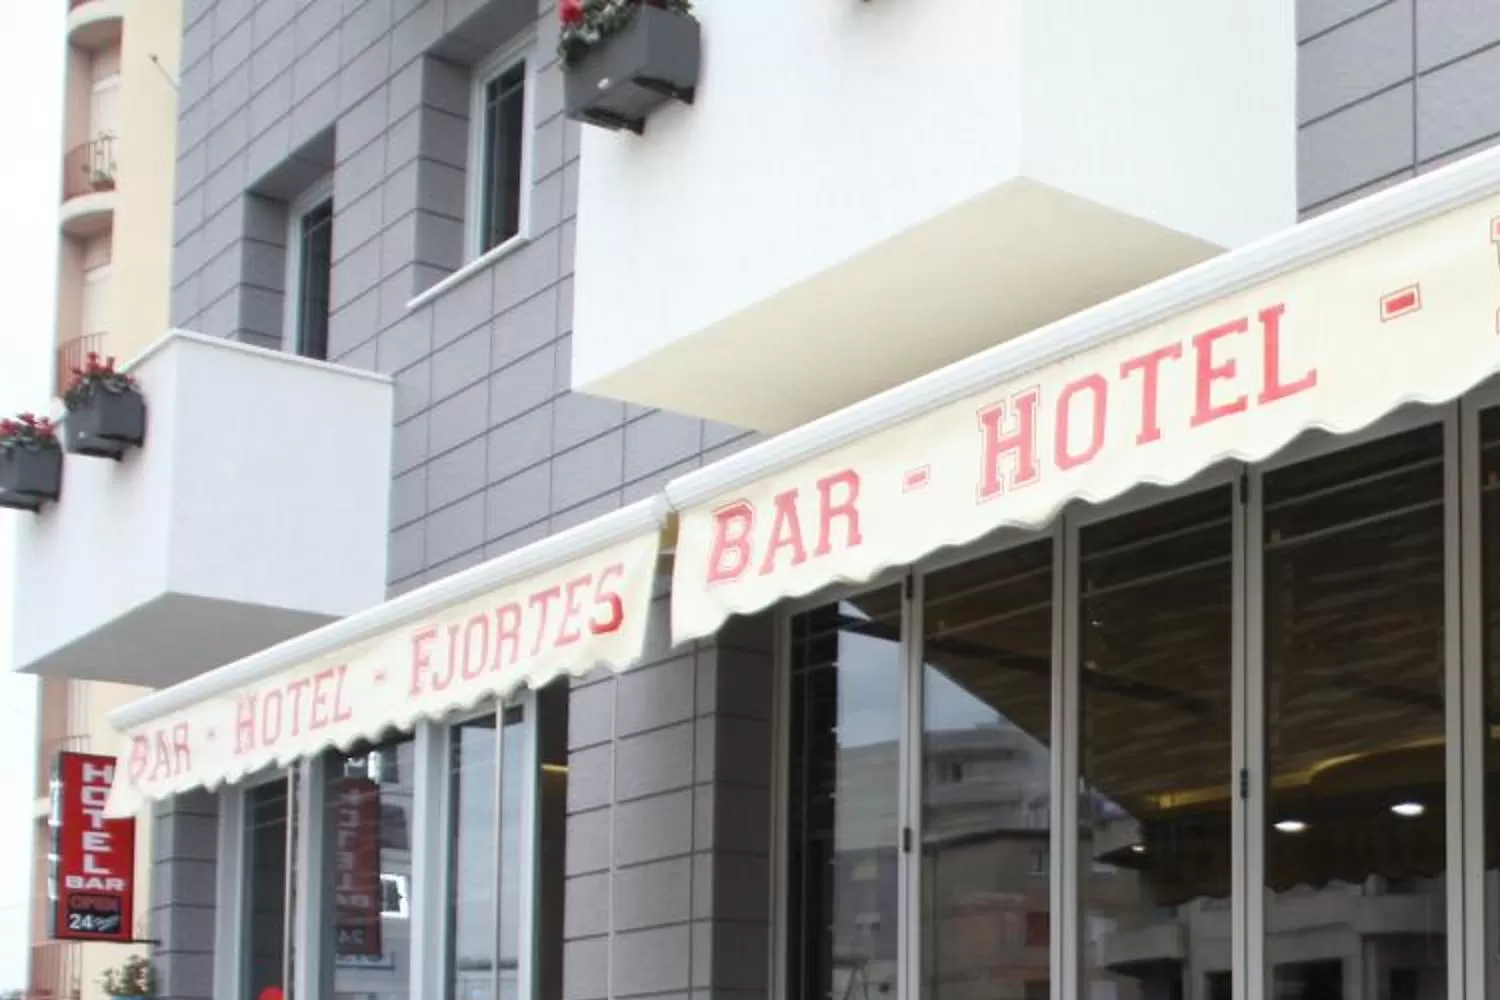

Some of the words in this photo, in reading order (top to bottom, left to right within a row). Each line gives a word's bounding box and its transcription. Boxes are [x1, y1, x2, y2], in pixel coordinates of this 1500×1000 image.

[704, 468, 863, 584] BAR
[975, 302, 1318, 504] HOTEL
[129, 720, 192, 784] BAR
[234, 664, 352, 757] HOTEL
[408, 562, 626, 698] FJORTES
[81, 763, 114, 875] HOTEL
[65, 875, 126, 891] BAR
[69, 913, 94, 930] 24
